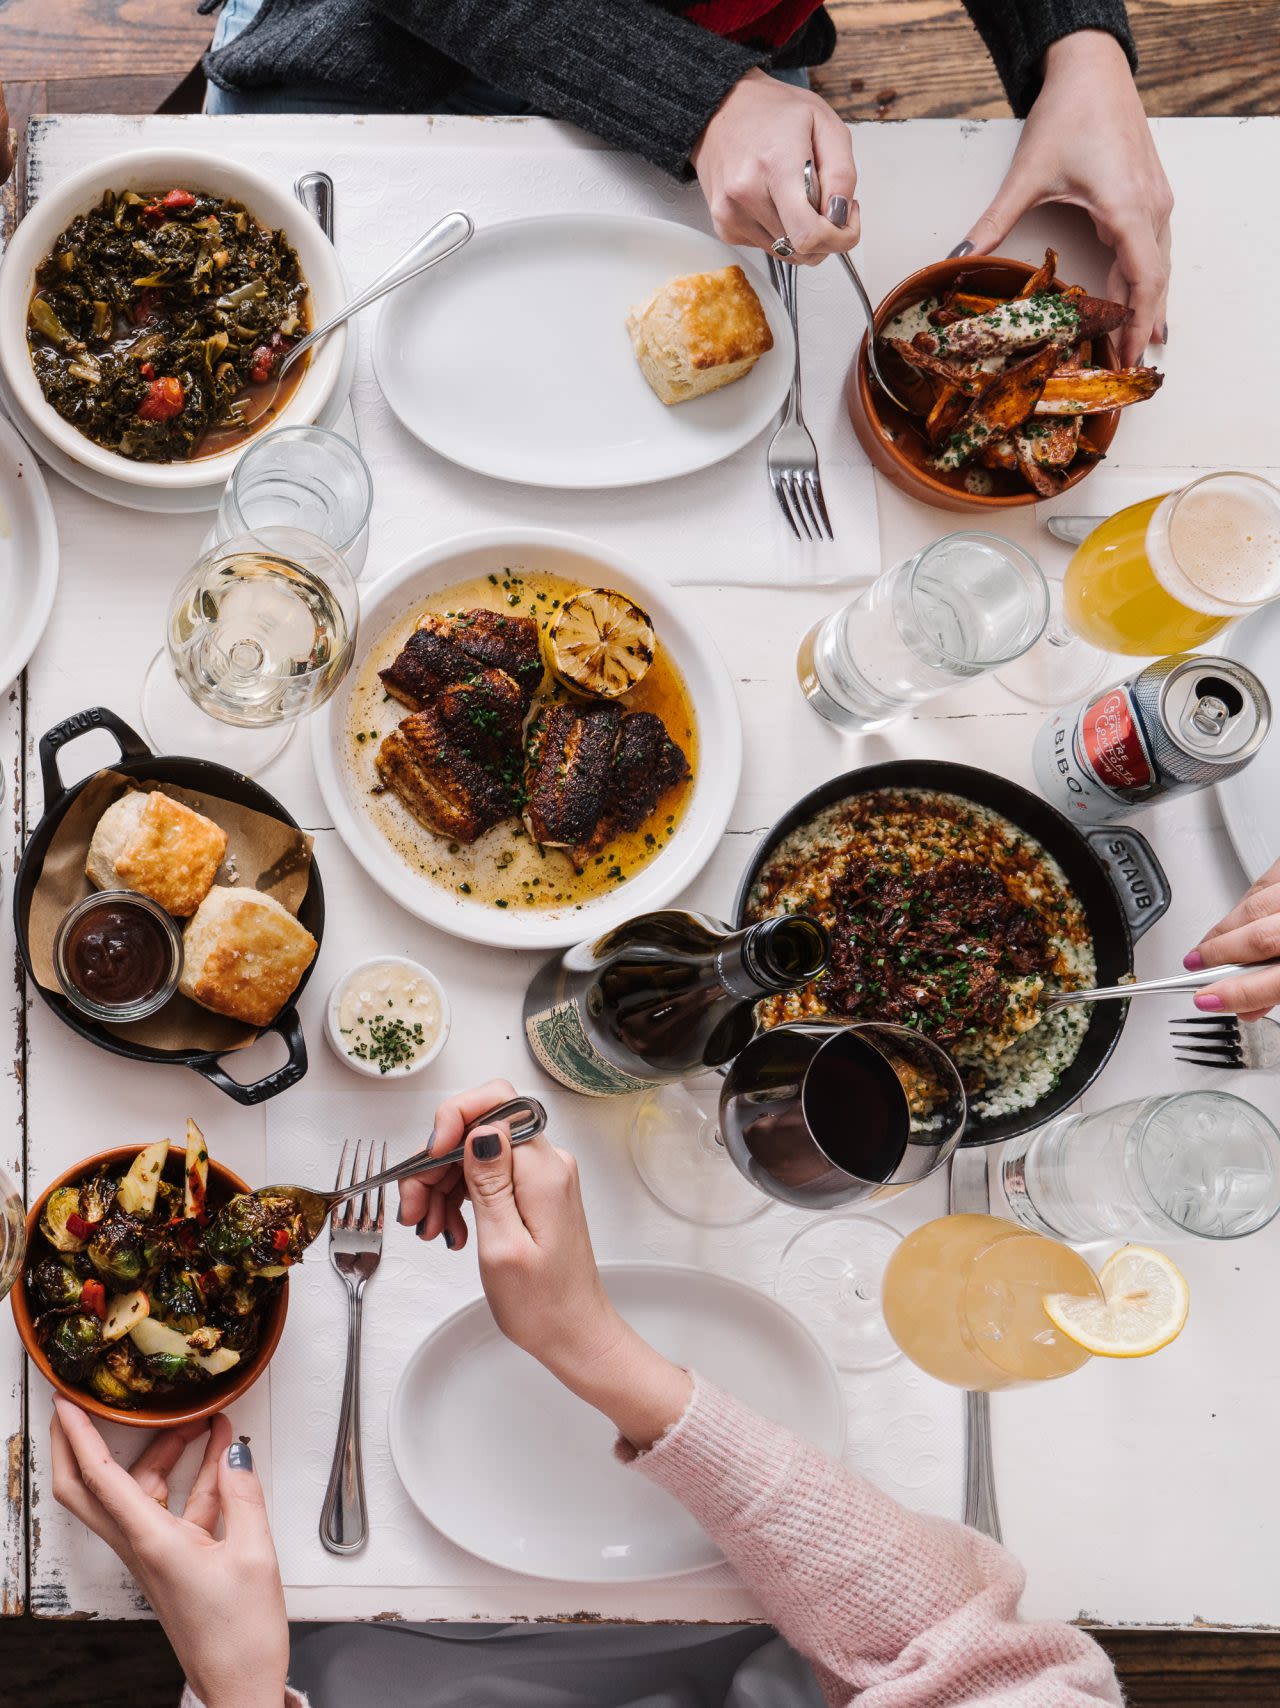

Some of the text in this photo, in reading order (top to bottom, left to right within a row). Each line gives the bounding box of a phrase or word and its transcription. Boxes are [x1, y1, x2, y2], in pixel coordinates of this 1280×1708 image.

[47, 709, 102, 745] STAUB
[1095, 714, 1137, 785] COMFORTS
[1103, 695, 1129, 762] CREATURE
[1055, 729, 1083, 793] BIBO
[1109, 840, 1153, 909] STAUB
